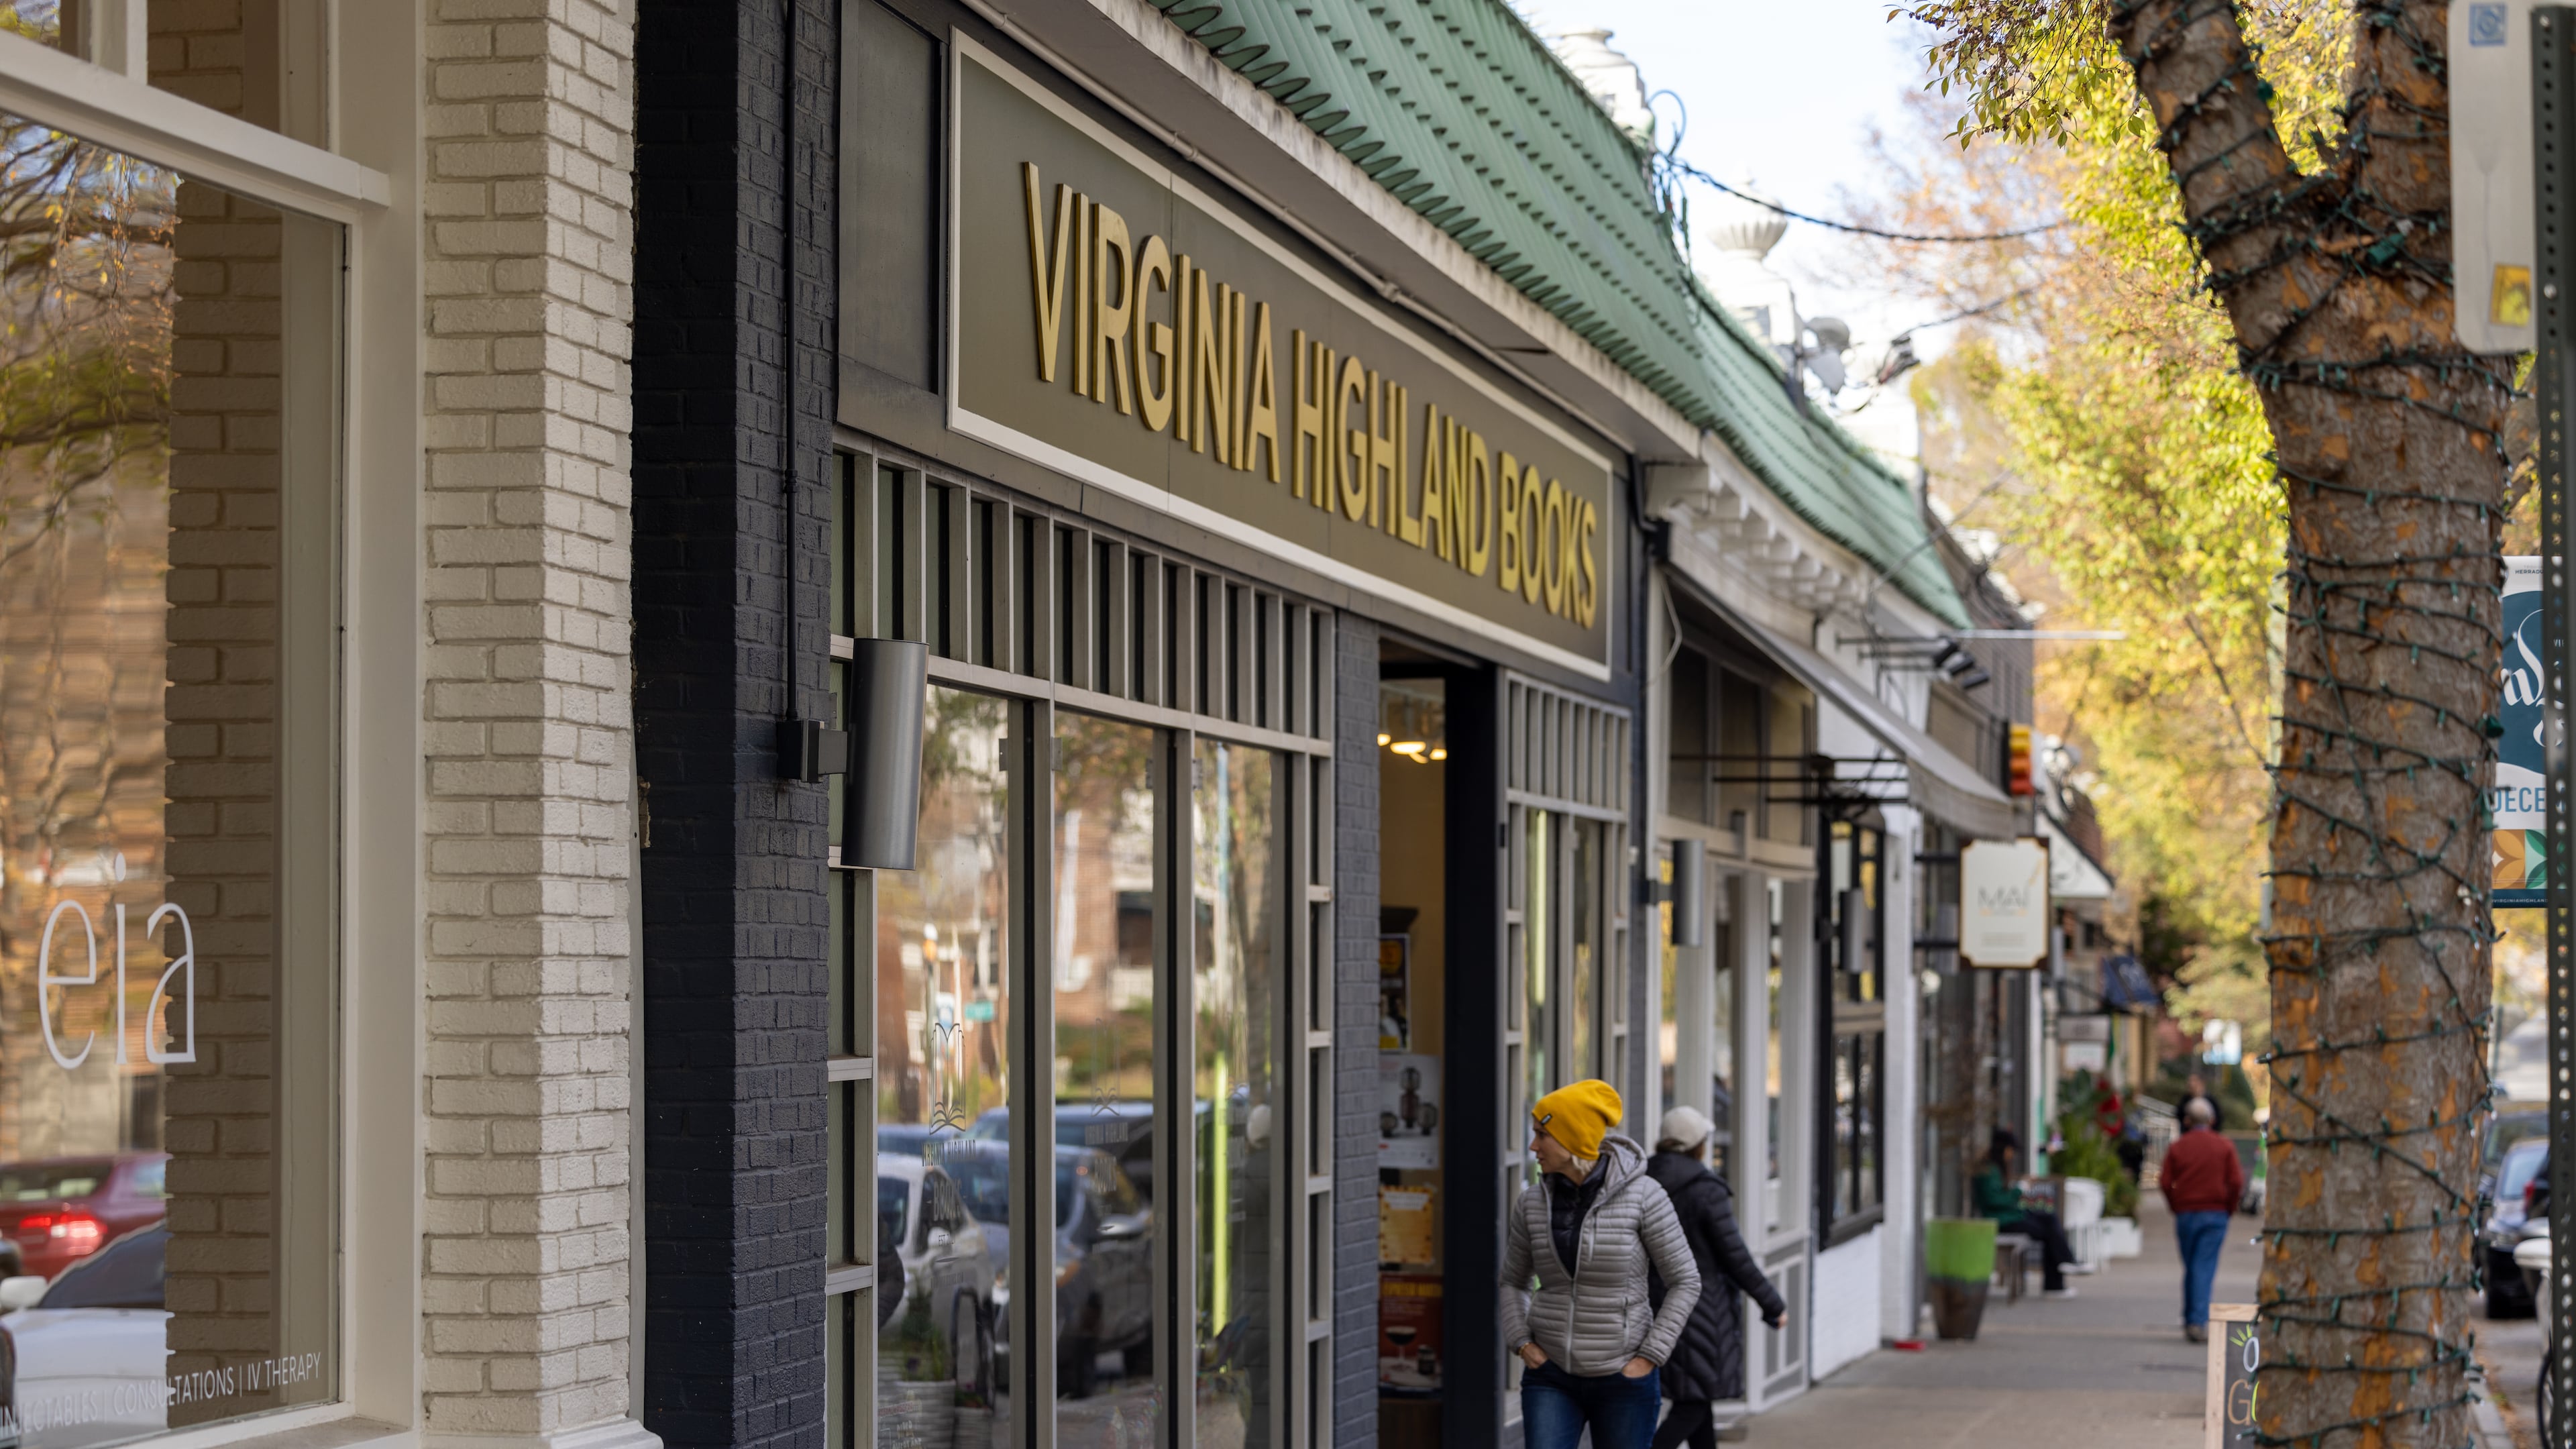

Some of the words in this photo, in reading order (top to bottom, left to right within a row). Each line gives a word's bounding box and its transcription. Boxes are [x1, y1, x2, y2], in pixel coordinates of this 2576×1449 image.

[1024, 161, 1281, 483] VIRGINIA
[1292, 329, 1492, 577] HIGHLAND
[1498, 450, 1597, 630] BOOKS
[38, 852, 197, 1070] eia
[113, 1366, 234, 1416] CONSULTATIONS
[248, 1362, 262, 1391] IV
[265, 1352, 321, 1387] THERAPY
